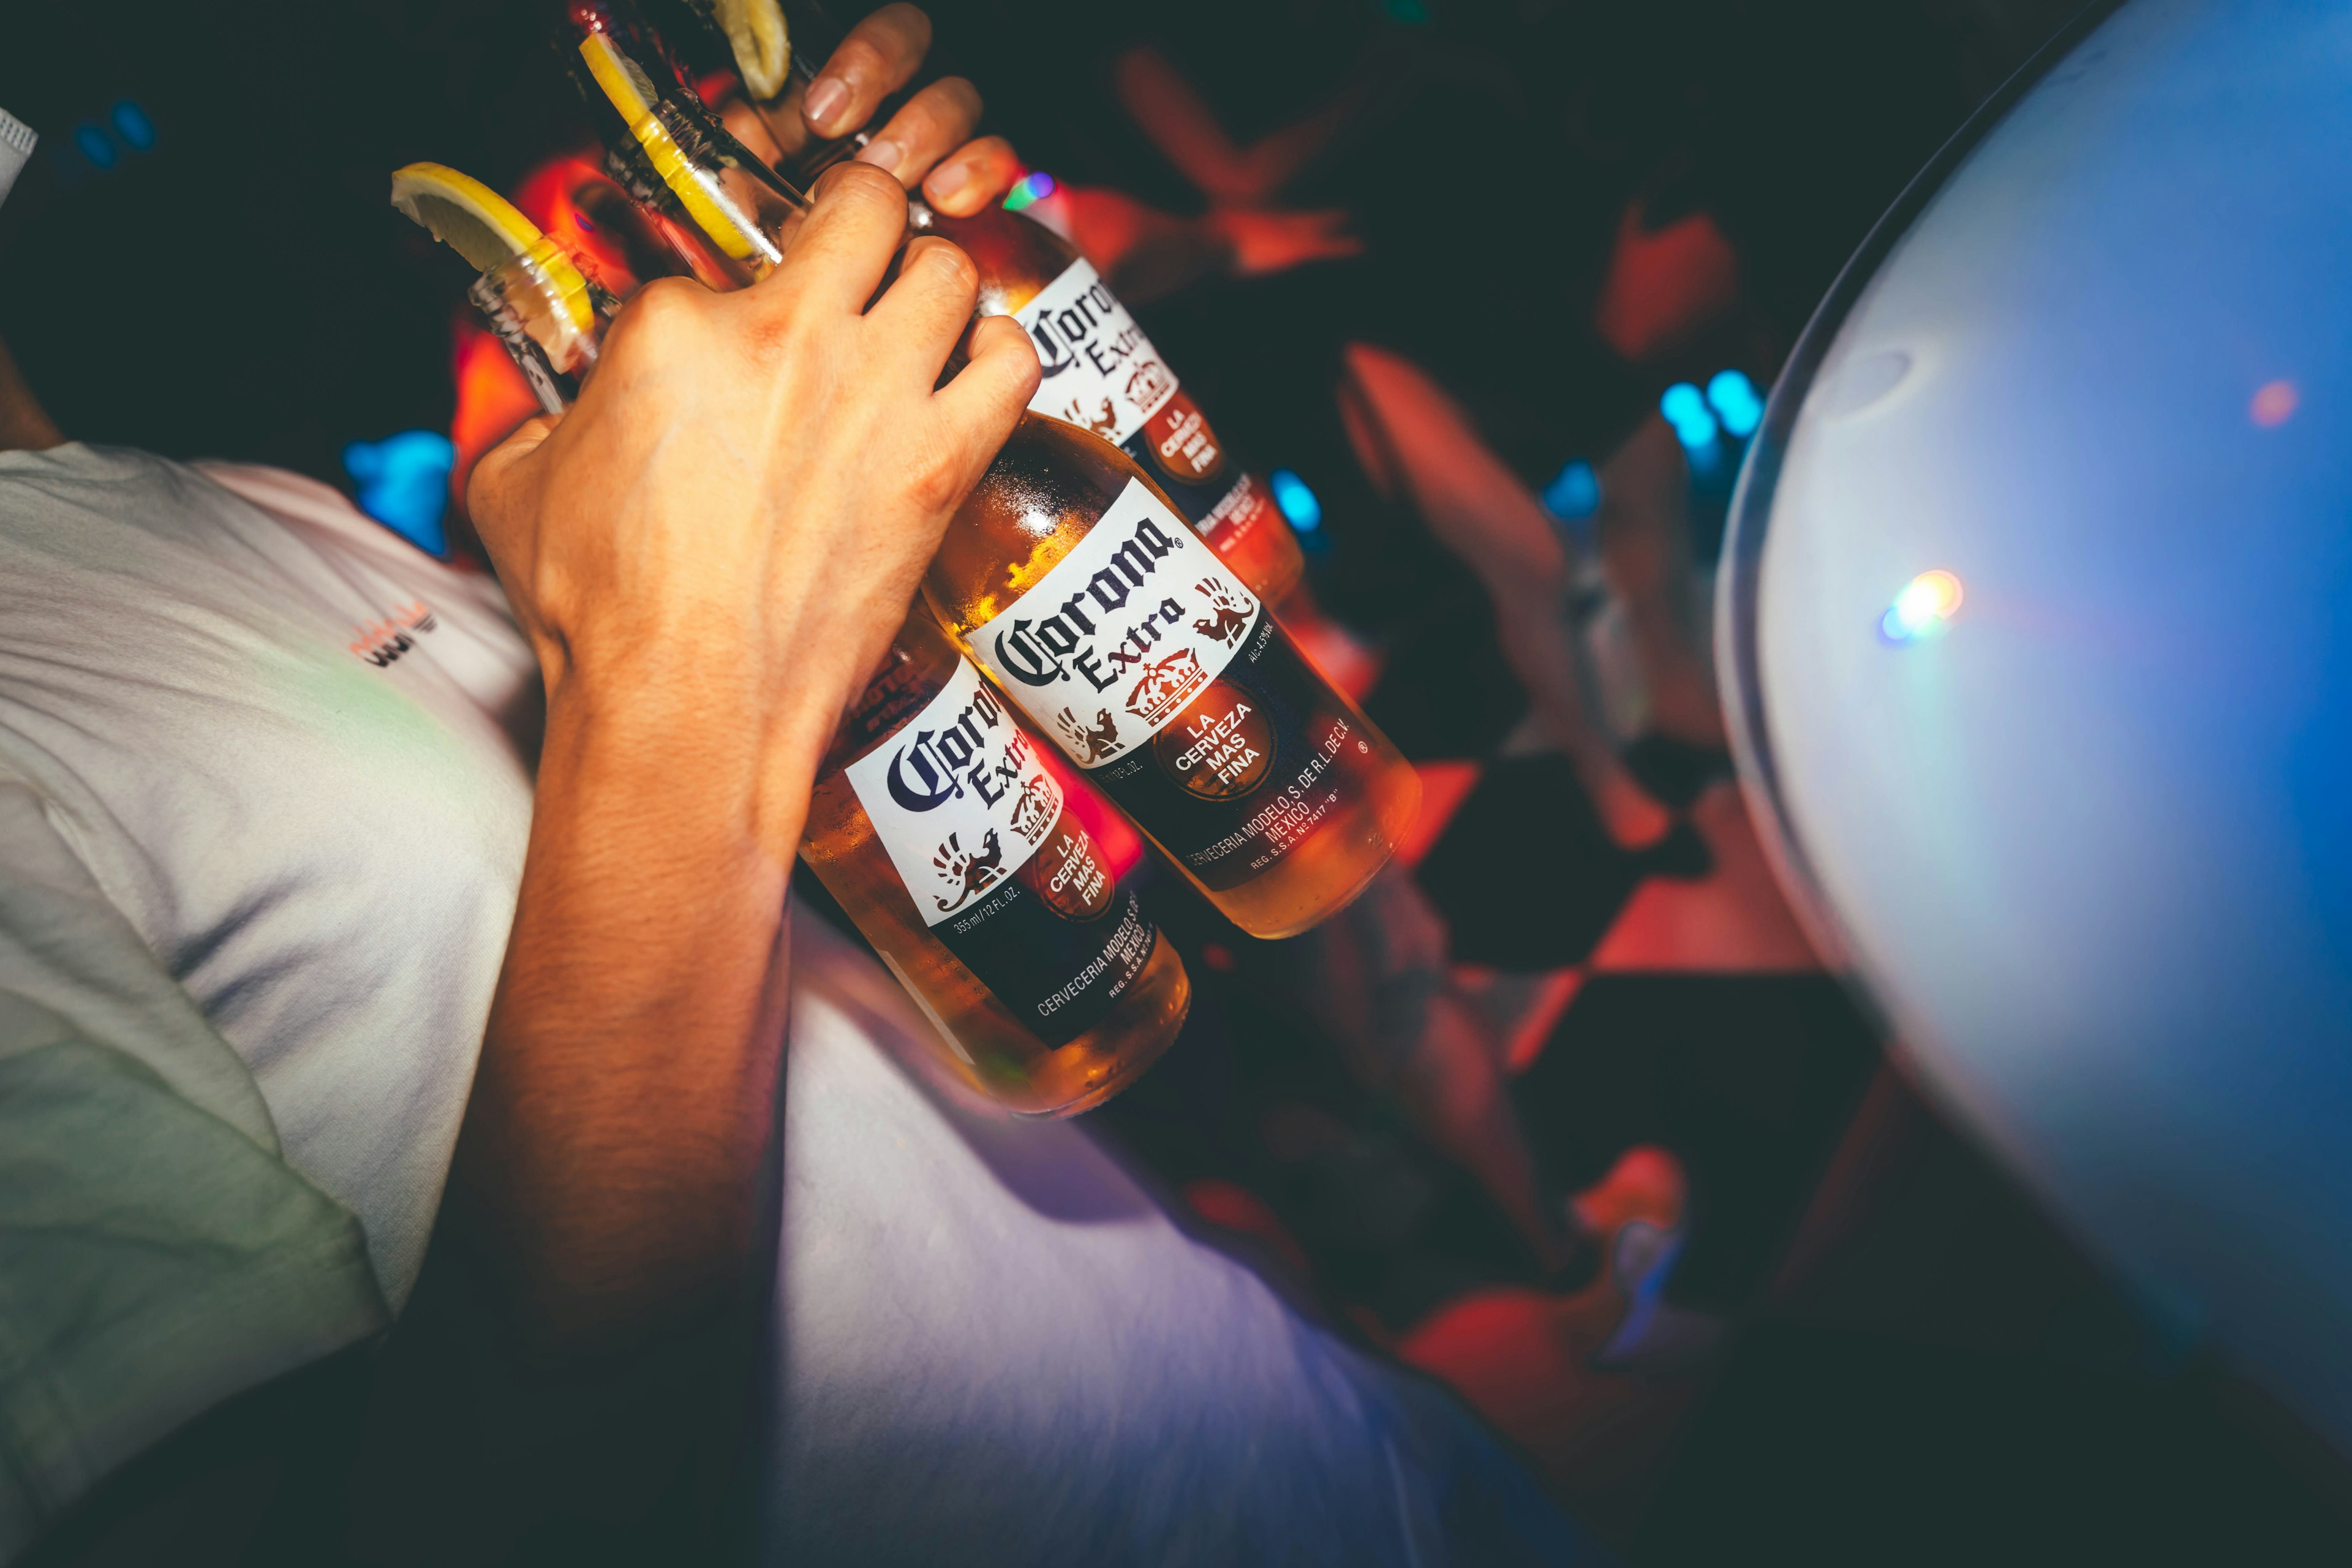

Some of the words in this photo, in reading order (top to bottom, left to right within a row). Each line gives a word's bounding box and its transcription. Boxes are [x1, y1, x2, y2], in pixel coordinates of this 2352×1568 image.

[994, 517, 1175, 687] Corona
[1072, 597, 1186, 694] Extra
[887, 680, 1003, 813] Coron
[1175, 703, 1252, 771] CERVEZA
[1186, 714, 1215, 739] LA
[1205, 733, 1246, 771] MAS
[1217, 747, 1261, 785] FINA
[1241, 796, 1295, 839] MODELO,
[1288, 785, 1304, 799] S.
[1297, 767, 1317, 789] DE
[1325, 734, 1341, 754] DE
[1333, 718, 1349, 740] C.V.
[1250, 855, 1273, 870] REG.
[1271, 835, 1298, 856] S.S.A.
[1306, 805, 1327, 826] 7417
[1265, 801, 1310, 844] MEXICO
[1050, 830, 1090, 893] CERVEZA
[1057, 834, 1074, 858] LA
[1072, 855, 1096, 891] MAS
[1082, 870, 1106, 906] FINA
[954, 919, 972, 935] 355
[1120, 924, 1145, 965] MEXICO
[1037, 956, 1108, 1017] CERVECERIA
[1102, 917, 1136, 962] MODELO,
[1109, 980, 1128, 998] REG.
